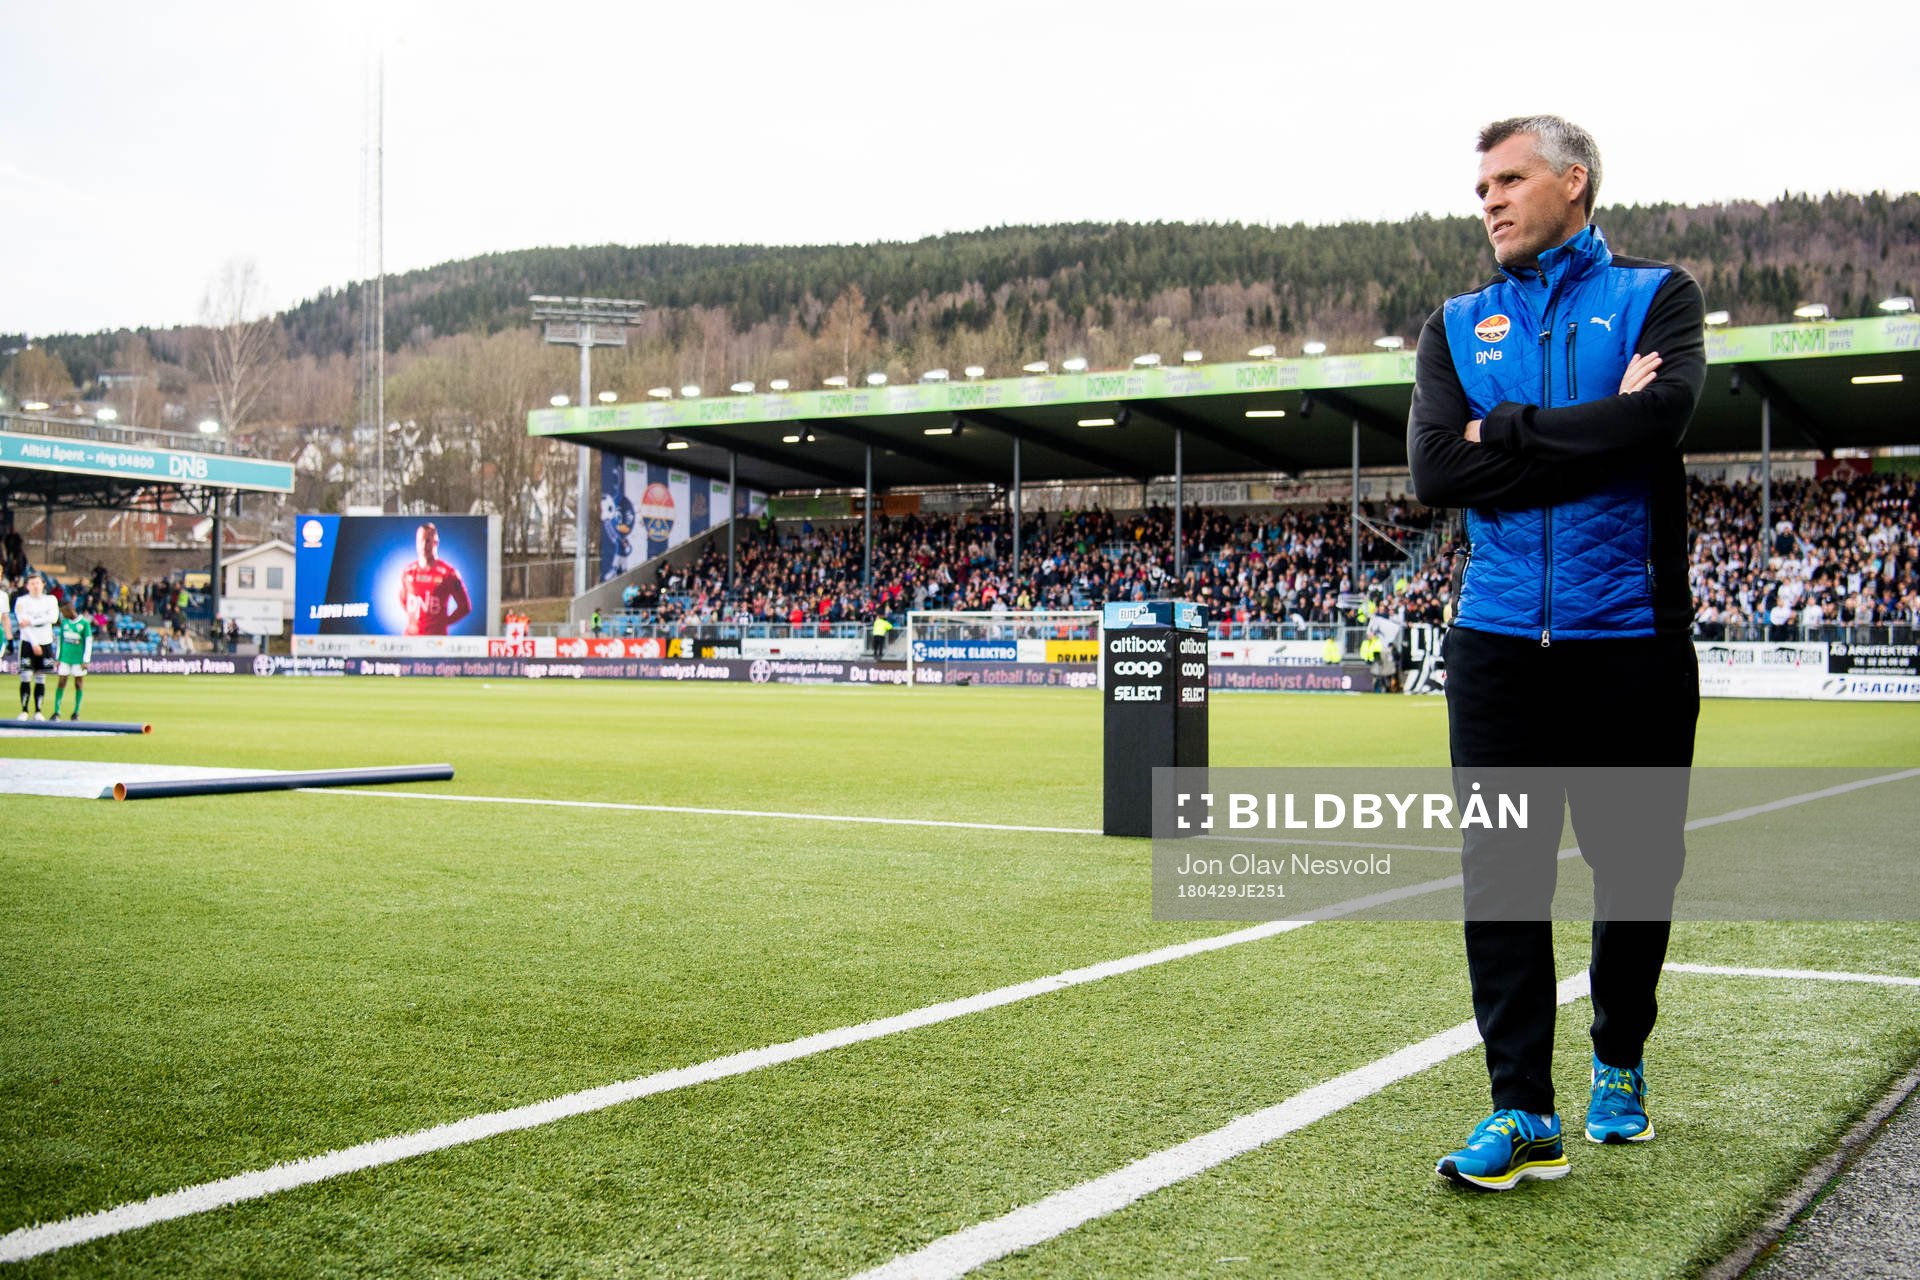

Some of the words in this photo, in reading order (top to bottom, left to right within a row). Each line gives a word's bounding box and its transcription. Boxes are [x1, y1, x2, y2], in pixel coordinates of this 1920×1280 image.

[1771, 328, 1825, 354] KIWI
[1476, 348, 1502, 365] DNB
[1235, 366, 1277, 388] KIWI
[95, 451, 116, 468] ring
[169, 453, 209, 480] DNB
[1110, 635, 1166, 653] altibox
[1180, 637, 1206, 654] altibox
[968, 646, 1016, 661] ELEKTRO
[142, 658, 201, 675] Marienlyst
[203, 658, 235, 673] Arena
[360, 660, 374, 675] Du
[375, 662, 411, 677] trenger
[413, 662, 433, 675] ikke
[463, 661, 494, 676] fotball
[496, 662, 511, 676] for
[521, 662, 547, 679] legge
[549, 664, 624, 679] arrangementet
[626, 662, 638, 677] til
[639, 663, 695, 680] Marienlyst
[696, 664, 729, 678] Arena
[771, 662, 815, 677] Marienlyst
[816, 662, 844, 675] Arena
[1114, 661, 1162, 678] coop
[1181, 663, 1205, 679] coop
[850, 666, 867, 681] Du
[916, 668, 943, 683] ikke
[983, 668, 1023, 685] fotball
[1026, 668, 1045, 685] for
[1060, 670, 1097, 688] legge
[1225, 672, 1302, 690] Marienlyst
[1304, 673, 1352, 689] Arena
[1114, 686, 1162, 701] SELECT
[1182, 687, 1205, 702] SELECT
